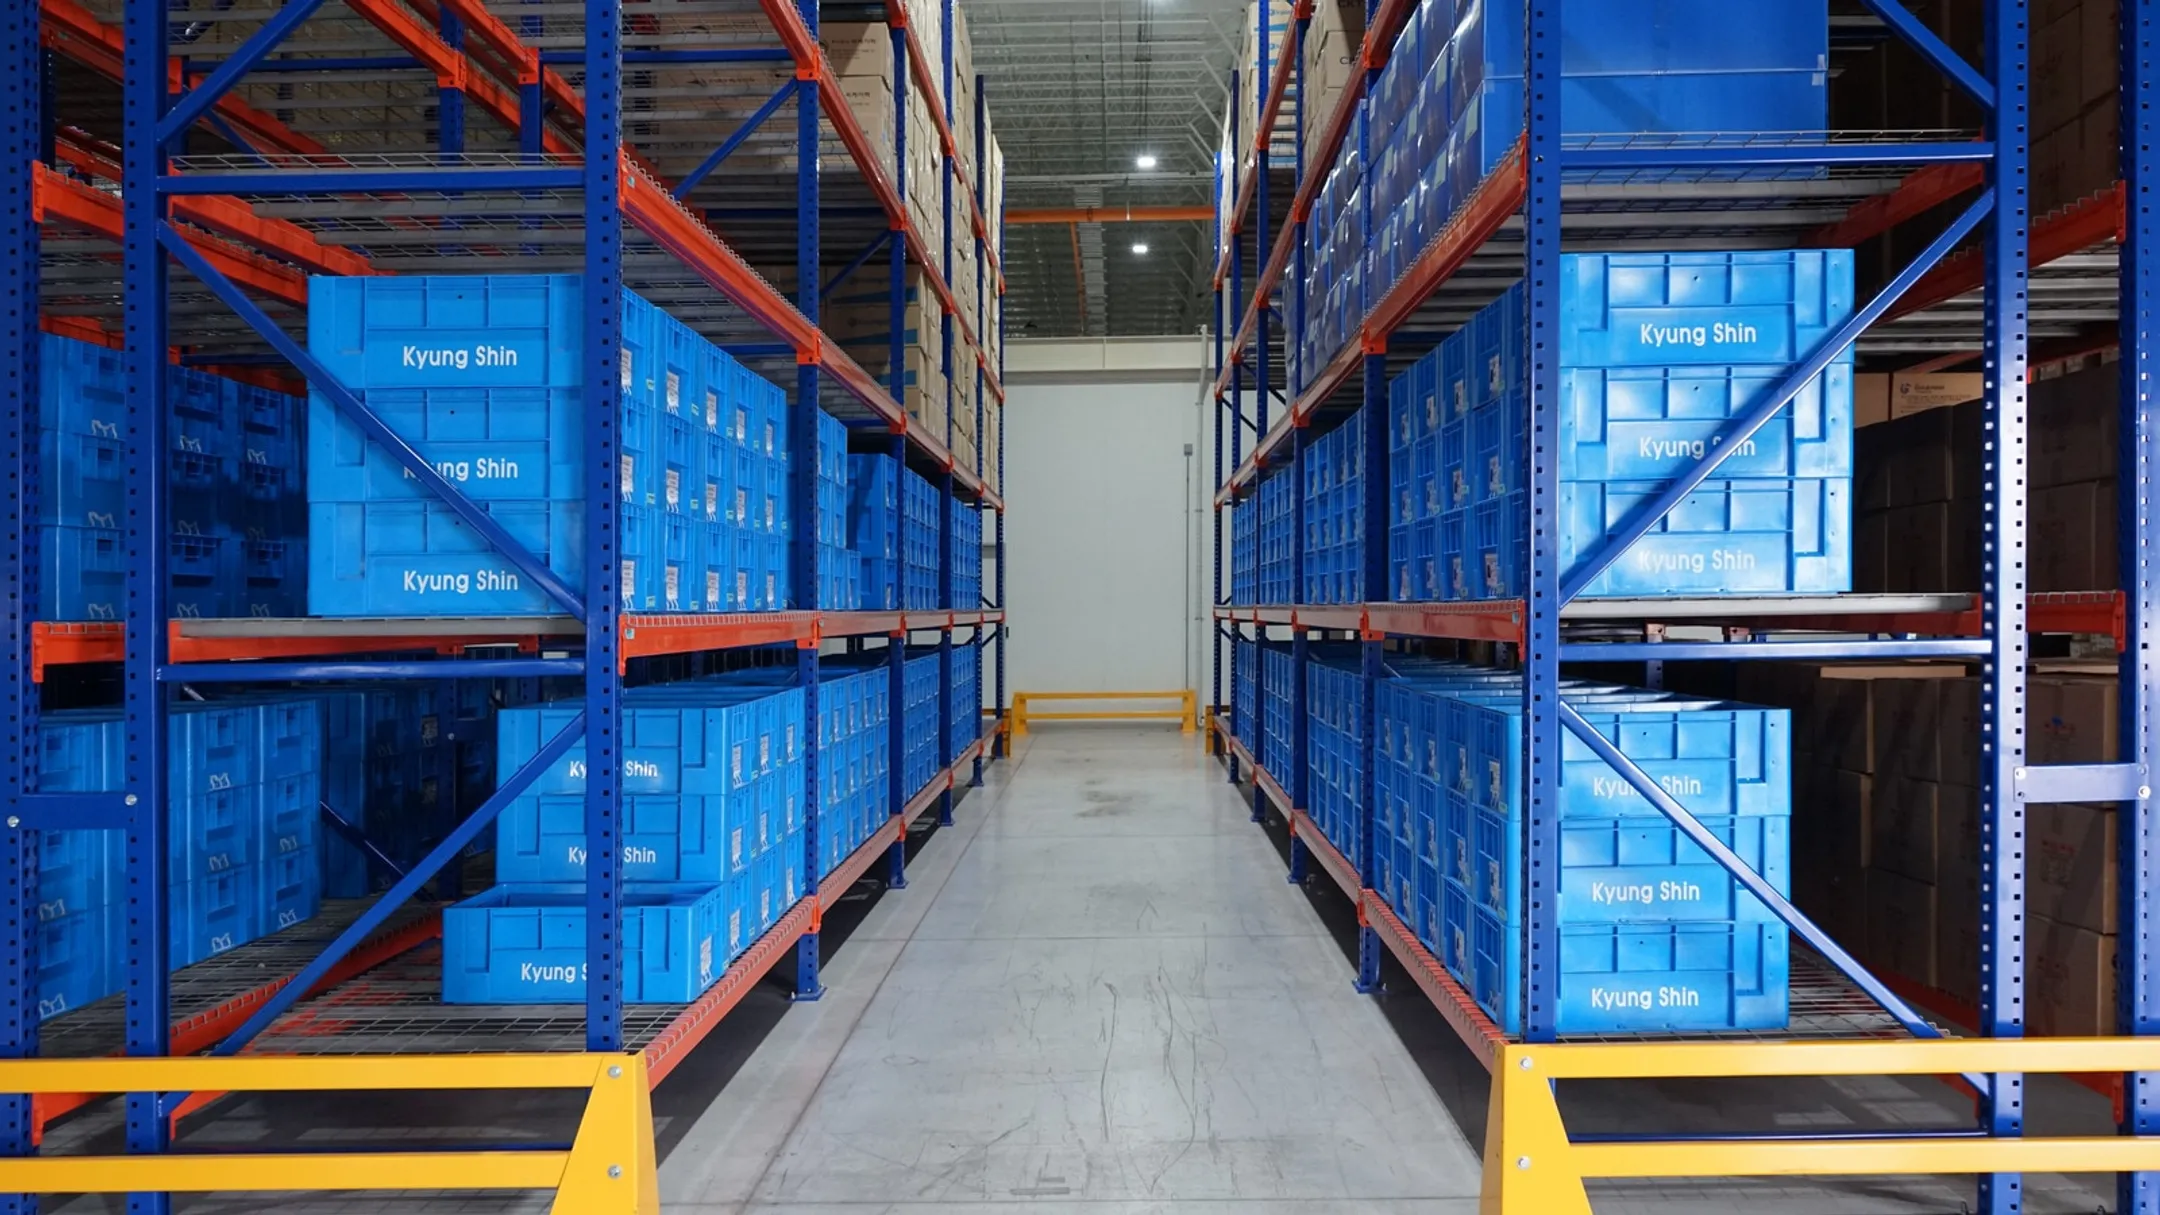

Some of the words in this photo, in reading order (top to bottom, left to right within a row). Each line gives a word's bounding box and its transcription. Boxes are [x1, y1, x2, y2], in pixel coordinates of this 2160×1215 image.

[1640, 323, 1706, 347] Kyung
[1713, 322, 1757, 343] Shin
[403, 345, 469, 370] Kyung
[475, 345, 517, 366] Shin
[1639, 436, 1705, 461] Kyung
[476, 457, 518, 478] Shin
[1638, 550, 1704, 575] Kyung
[1712, 549, 1756, 570] Shin
[403, 570, 469, 594] Kyung
[476, 569, 518, 590] Shin
[625, 760, 659, 778] Shin
[1661, 775, 1702, 795] Shin
[623, 846, 657, 863] Shin
[1591, 881, 1653, 905] Kyung
[1660, 881, 1701, 901] Shin
[521, 962, 577, 984] Kyung
[1591, 987, 1653, 1010] Kyung
[1659, 986, 1699, 1006] Shin
